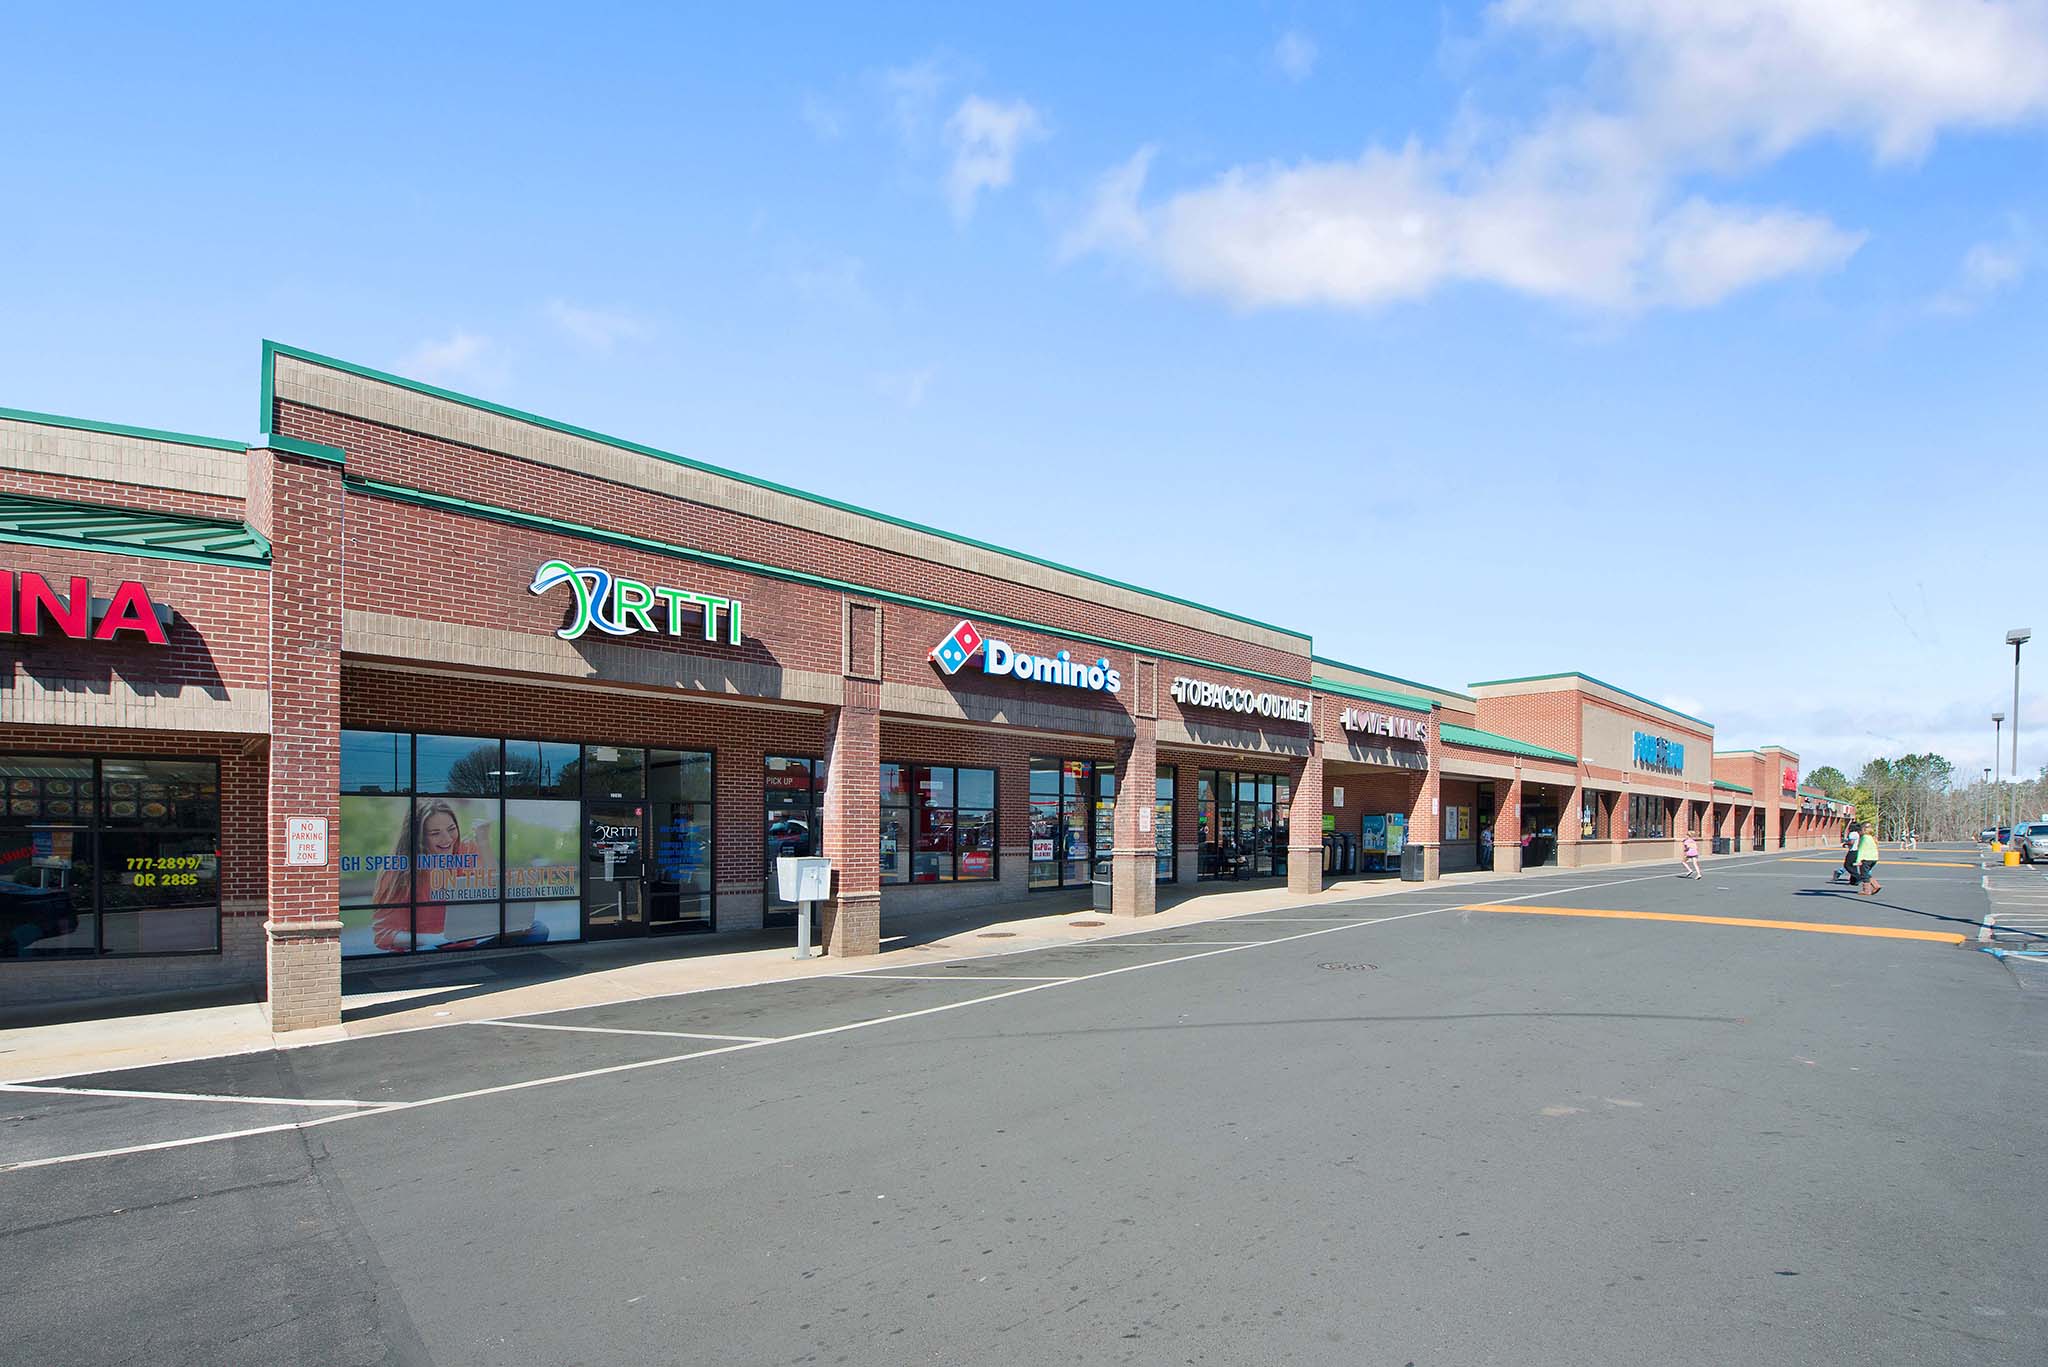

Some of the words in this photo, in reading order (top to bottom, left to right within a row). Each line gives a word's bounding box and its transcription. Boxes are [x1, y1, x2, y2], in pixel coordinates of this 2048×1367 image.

[613, 577, 742, 647] RTTI
[983, 639, 1121, 693] Domino's
[1177, 677, 1255, 714] TOBACCO
[1257, 692, 1313, 723] OUTLET
[766, 776, 782, 785] PICK
[783, 777, 793, 785] UP
[301, 823, 314, 831] NO
[610, 826, 638, 837] RTTI
[291, 832, 323, 841] PARKING
[299, 843, 316, 852] FIRE
[296, 852, 318, 860] ZONE
[365, 855, 408, 871] SPEED
[417, 853, 479, 869] INTERNET
[133, 873, 156, 887] OR
[161, 873, 199, 886] 2885
[430, 869, 457, 890] ON
[463, 867, 497, 889] THE
[431, 888, 455, 900] MOST
[457, 887, 497, 899] RELIABLE
[507, 887, 532, 897] FIBER
[535, 885, 576, 897] NETWORK
